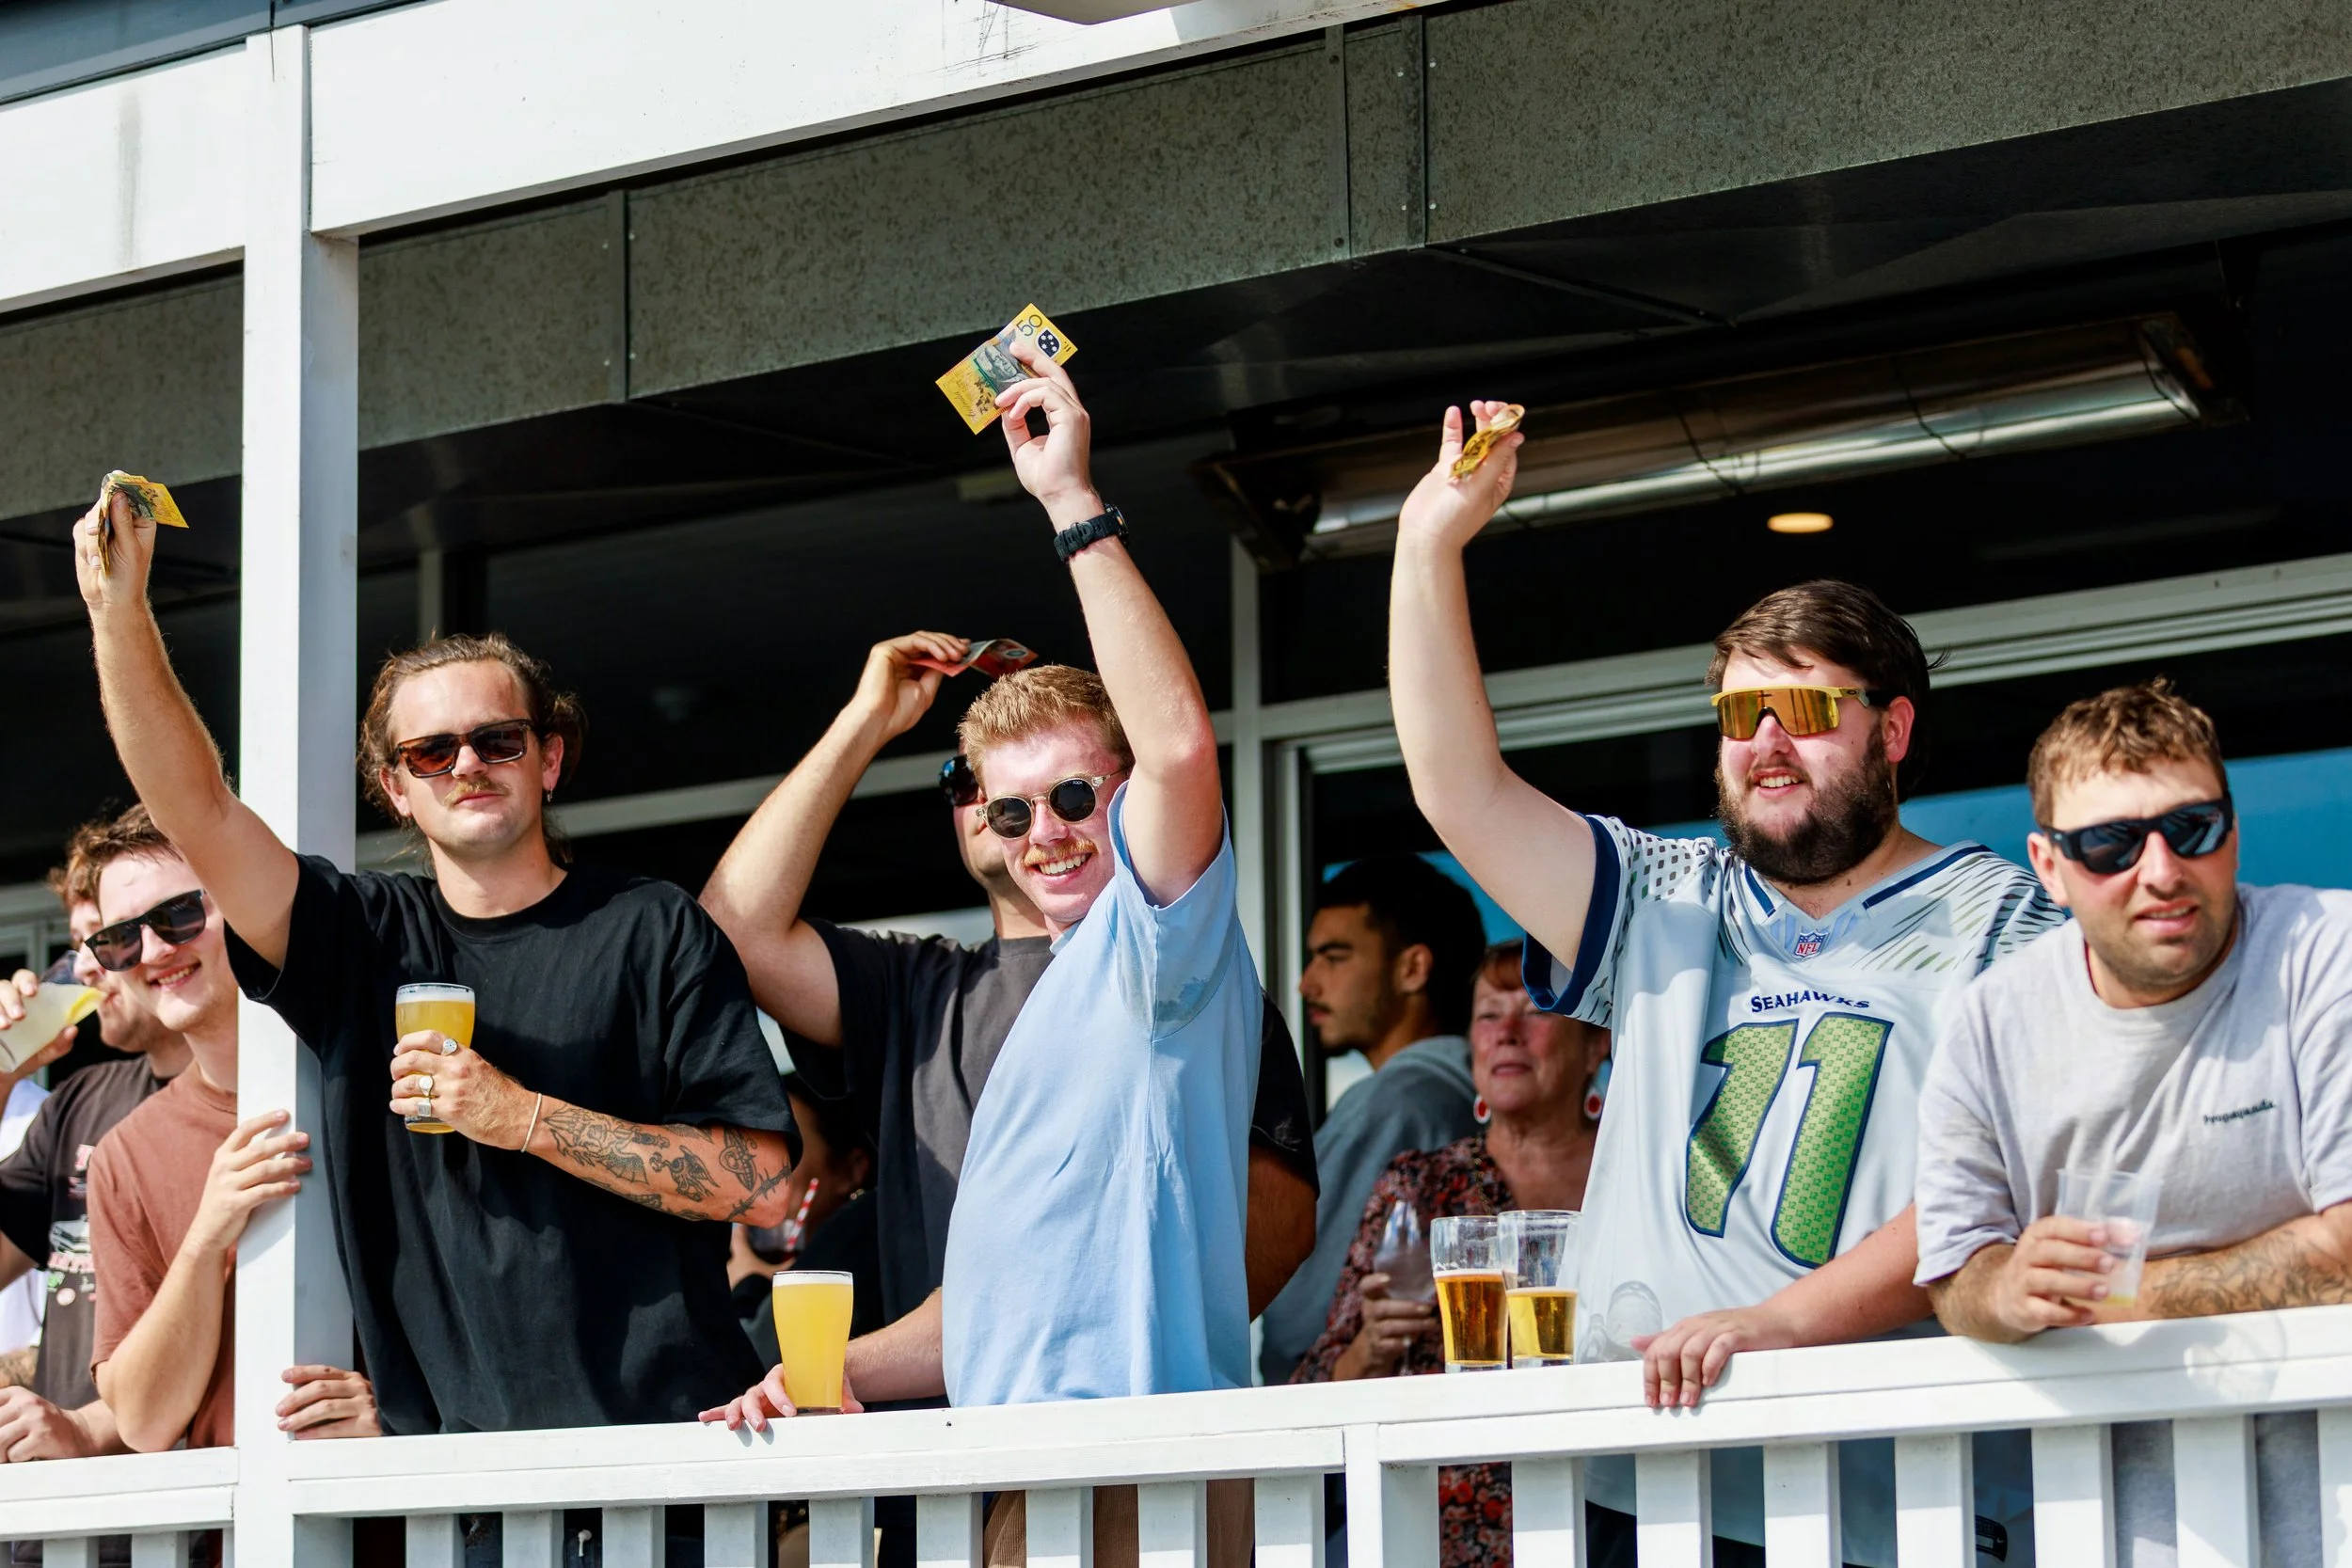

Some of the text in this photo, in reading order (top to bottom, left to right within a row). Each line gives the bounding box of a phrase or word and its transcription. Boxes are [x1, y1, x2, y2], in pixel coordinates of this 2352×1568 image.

[1016, 314, 1042, 337] 50
[1797, 942, 1818, 955] NFL
[1751, 990, 1869, 1013] SEAHAWKS
[1686, 1012, 1895, 1269] 11
